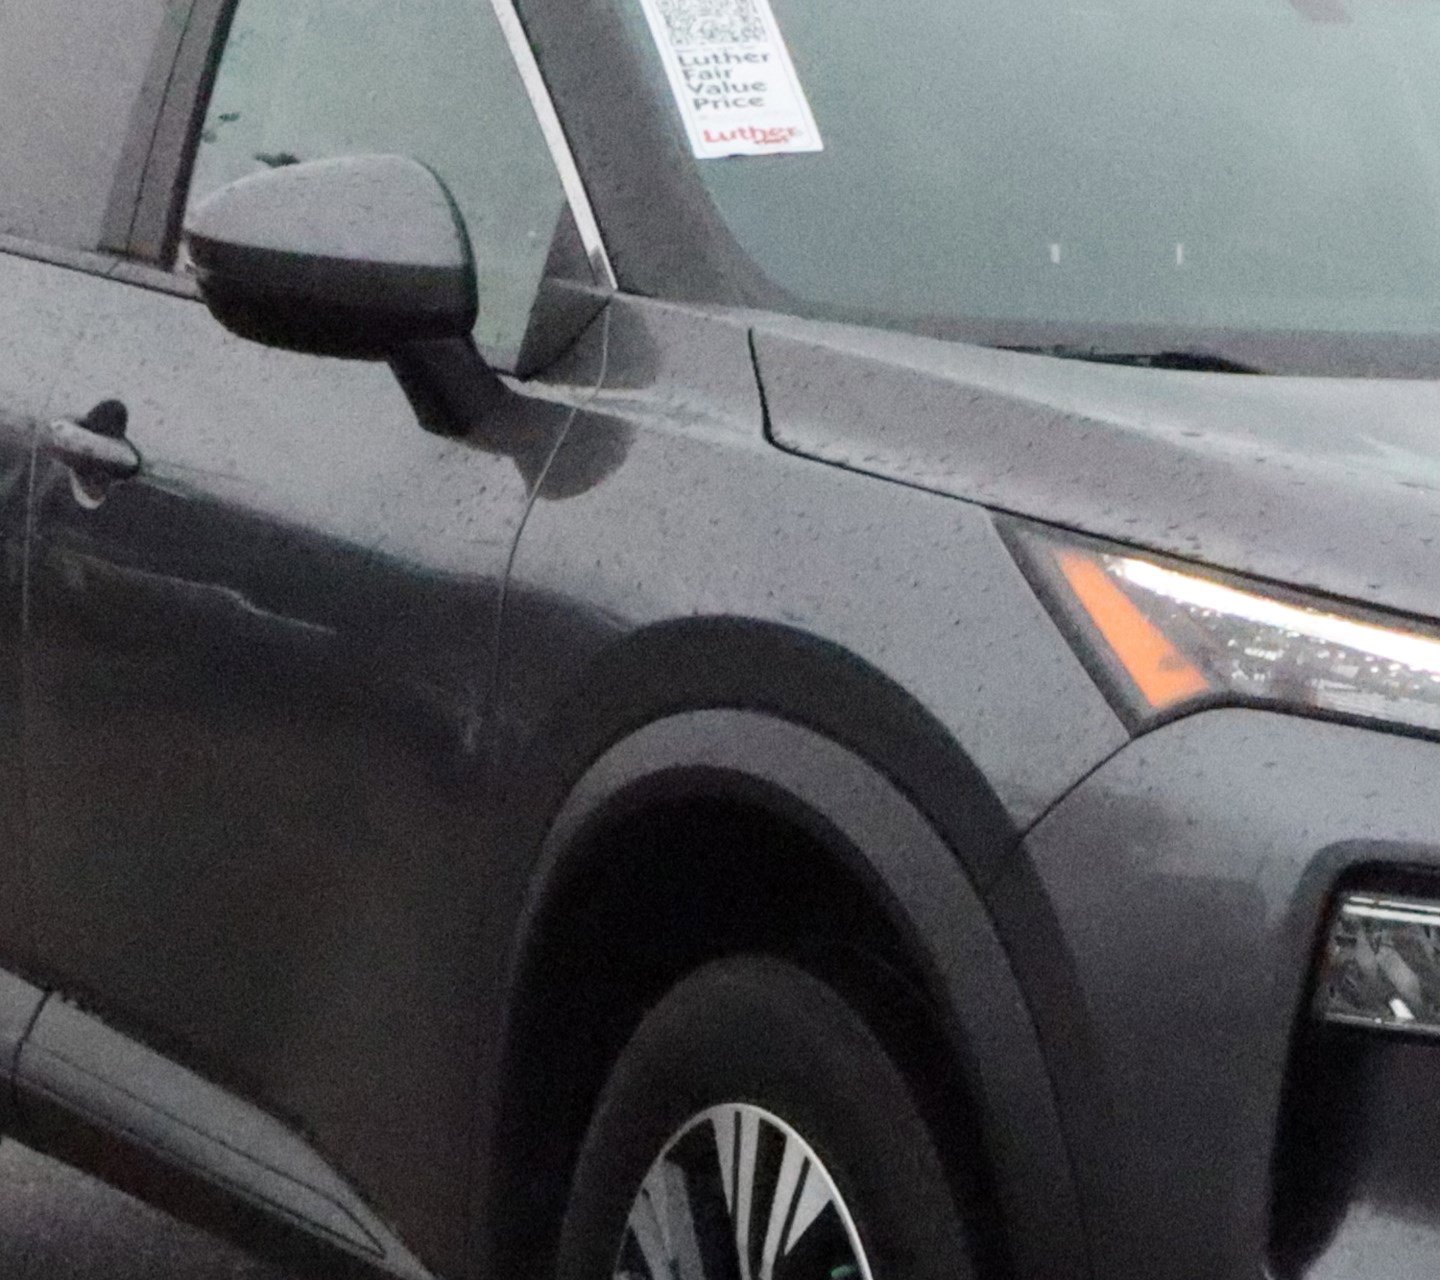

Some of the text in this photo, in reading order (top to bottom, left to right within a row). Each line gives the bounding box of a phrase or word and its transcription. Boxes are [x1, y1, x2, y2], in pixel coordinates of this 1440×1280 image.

[678, 51, 769, 67] Luther
[682, 67, 732, 81] Fair
[686, 81, 768, 96] Value
[692, 96, 766, 112] Price
[702, 125, 797, 144] Luther
